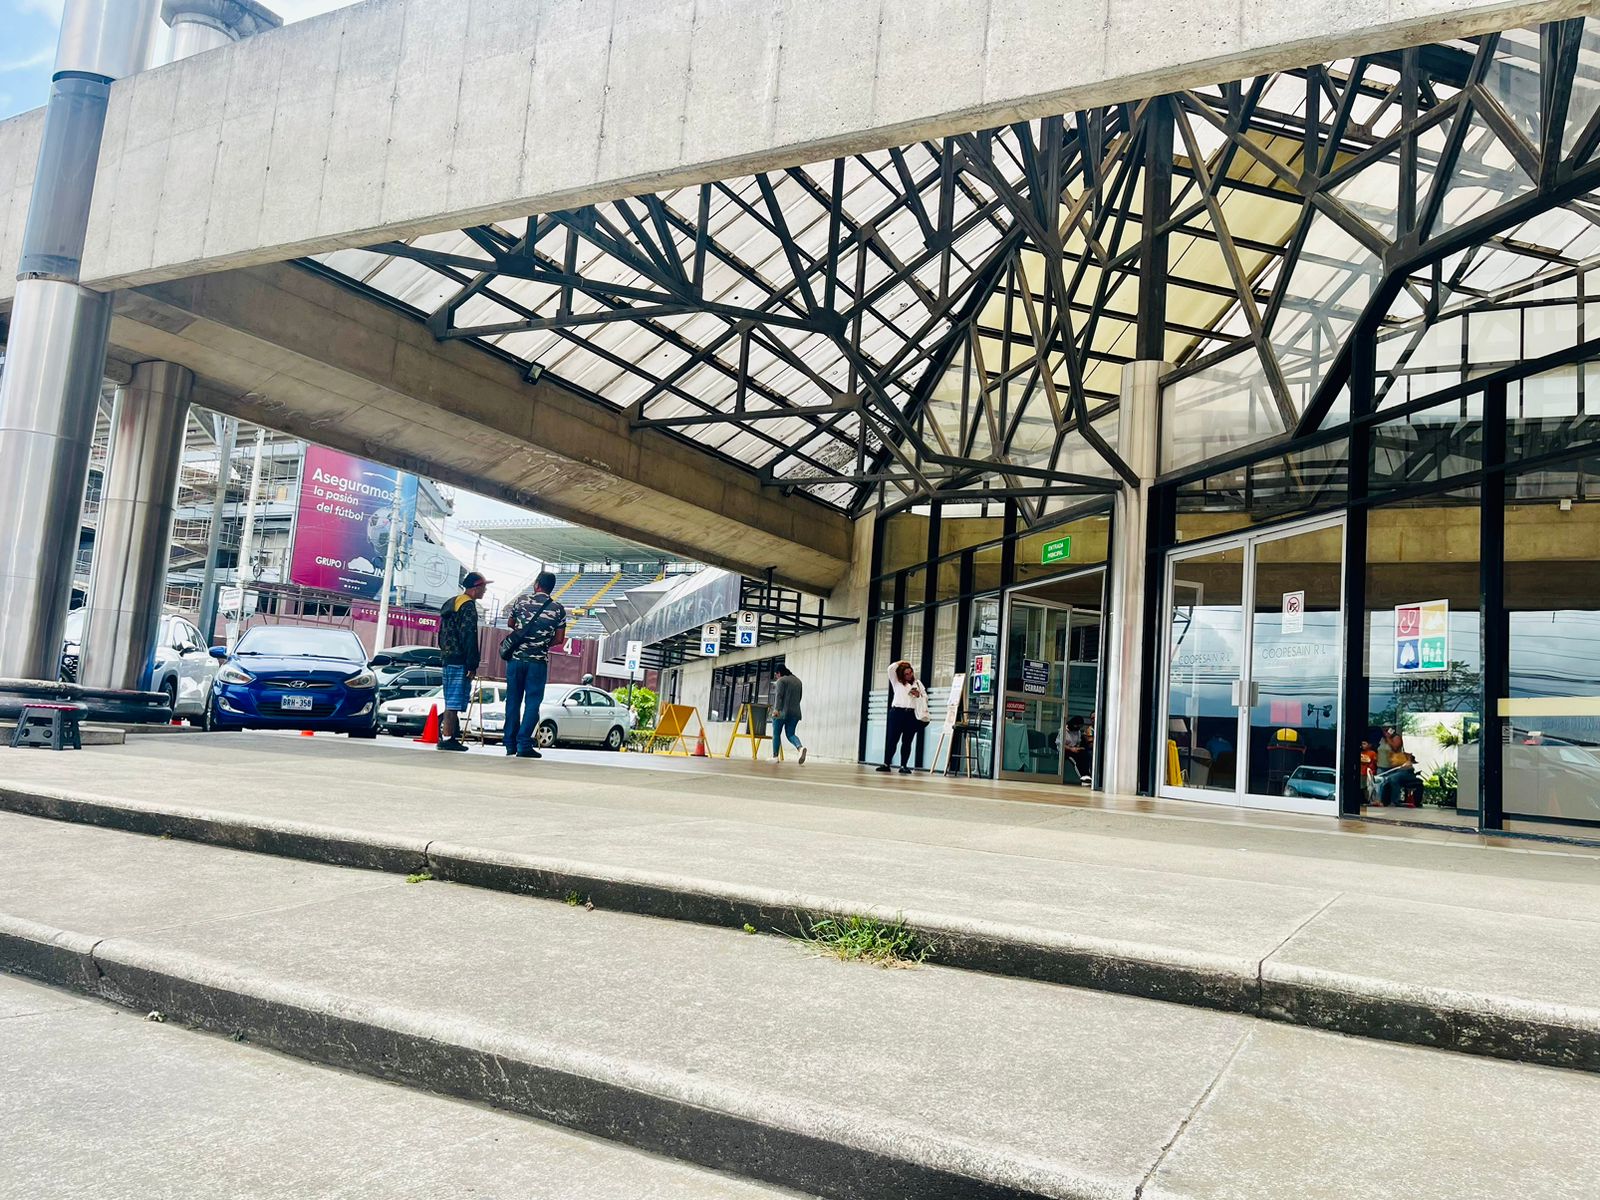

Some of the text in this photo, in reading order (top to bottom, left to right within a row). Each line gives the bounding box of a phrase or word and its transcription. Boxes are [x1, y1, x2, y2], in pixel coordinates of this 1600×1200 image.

[312, 467, 395, 502] Aseguramos
[313, 485, 359, 506] la pasión
[316, 502, 364, 521] del fútbol
[315, 556, 386, 579] GRUPO IN
[418, 617, 437, 627] OESTE
[745, 613, 752, 623] E
[709, 626, 715, 635] E
[563, 638, 573, 655] 4
[1262, 646, 1310, 660] COOPESAIN
[1178, 653, 1219, 666] COOPESAIN
[1392, 678, 1449, 695] COOPESAIN
